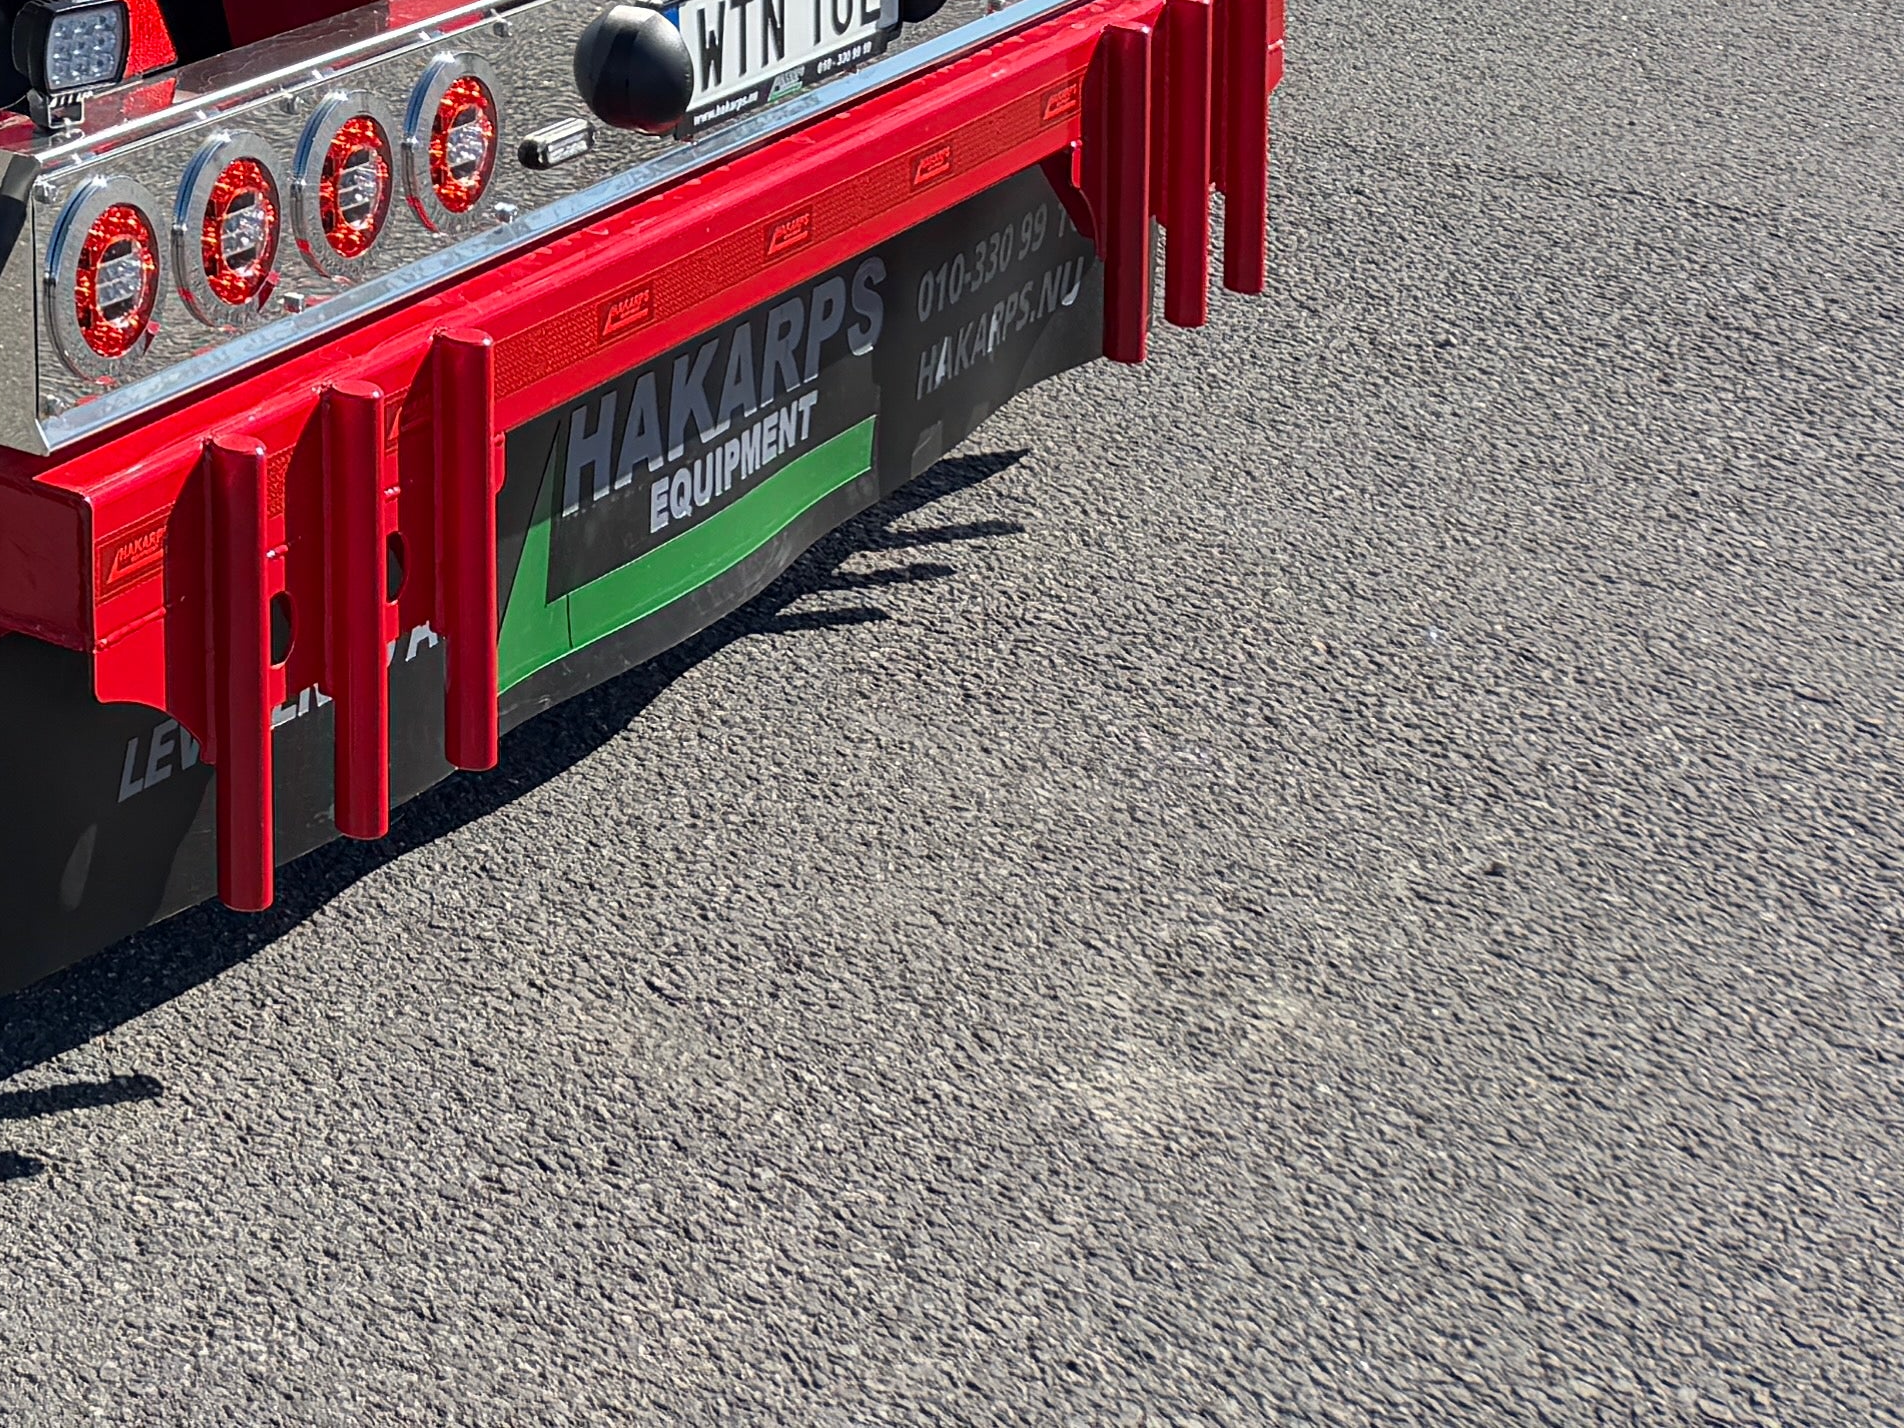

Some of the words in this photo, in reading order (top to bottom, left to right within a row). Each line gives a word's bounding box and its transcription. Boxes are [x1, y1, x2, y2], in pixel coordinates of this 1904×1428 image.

[916, 255, 1084, 401] HAKARPS.NU
[917, 223, 1014, 323] 010-330
[1018, 202, 1048, 261] 99
[562, 256, 887, 518] HAKARPS
[650, 390, 819, 534] EQUIPMENT
[117, 526, 166, 562] HAKARP
